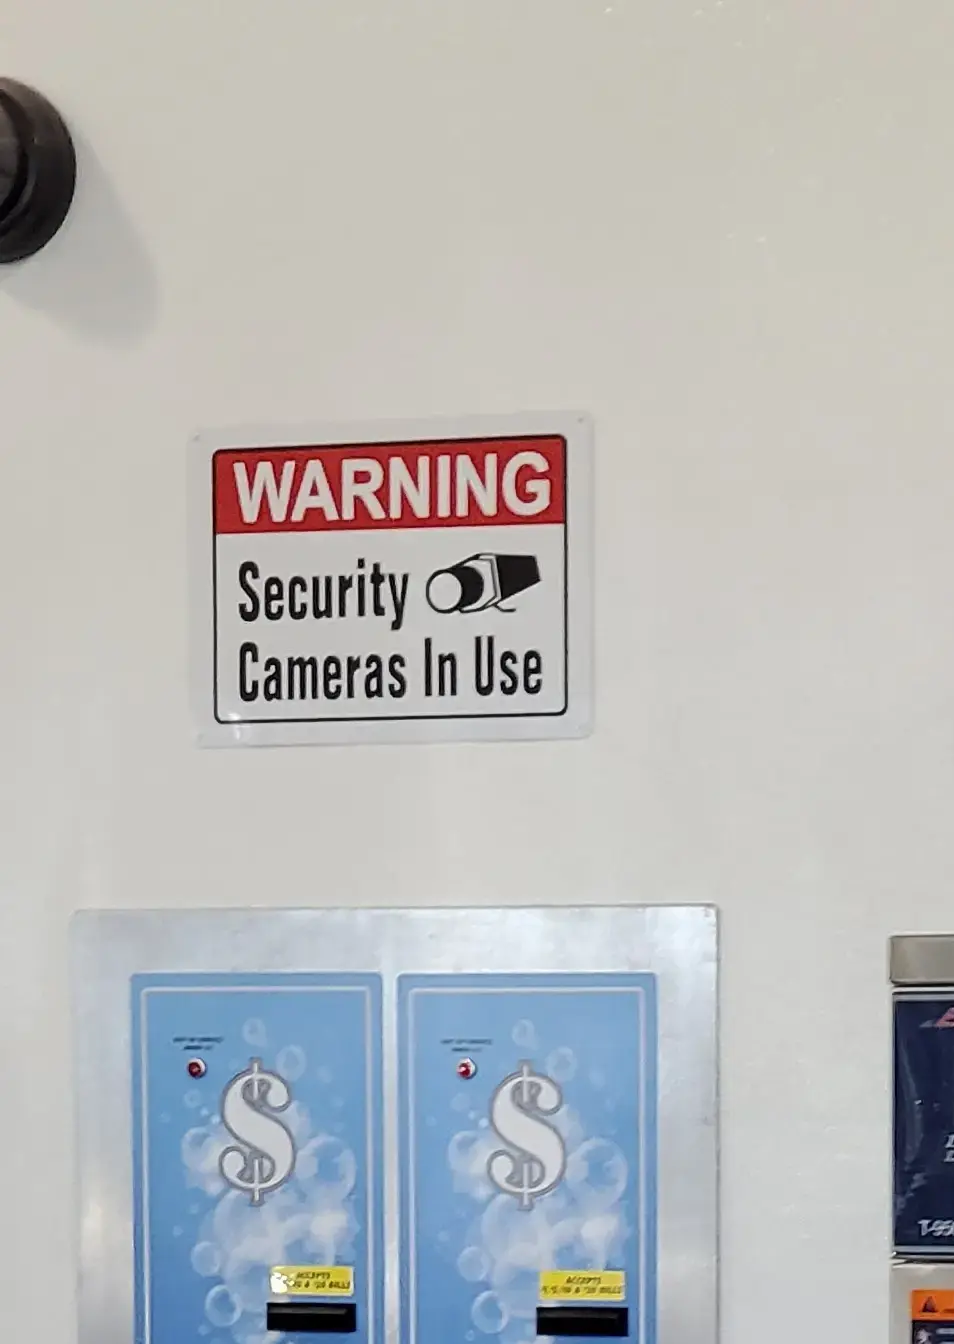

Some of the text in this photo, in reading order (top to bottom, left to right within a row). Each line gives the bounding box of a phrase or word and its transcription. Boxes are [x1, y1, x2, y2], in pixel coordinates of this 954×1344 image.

[232, 450, 551, 524] WARNING
[238, 558, 409, 631] Security
[239, 635, 543, 702] Cameras In Use
